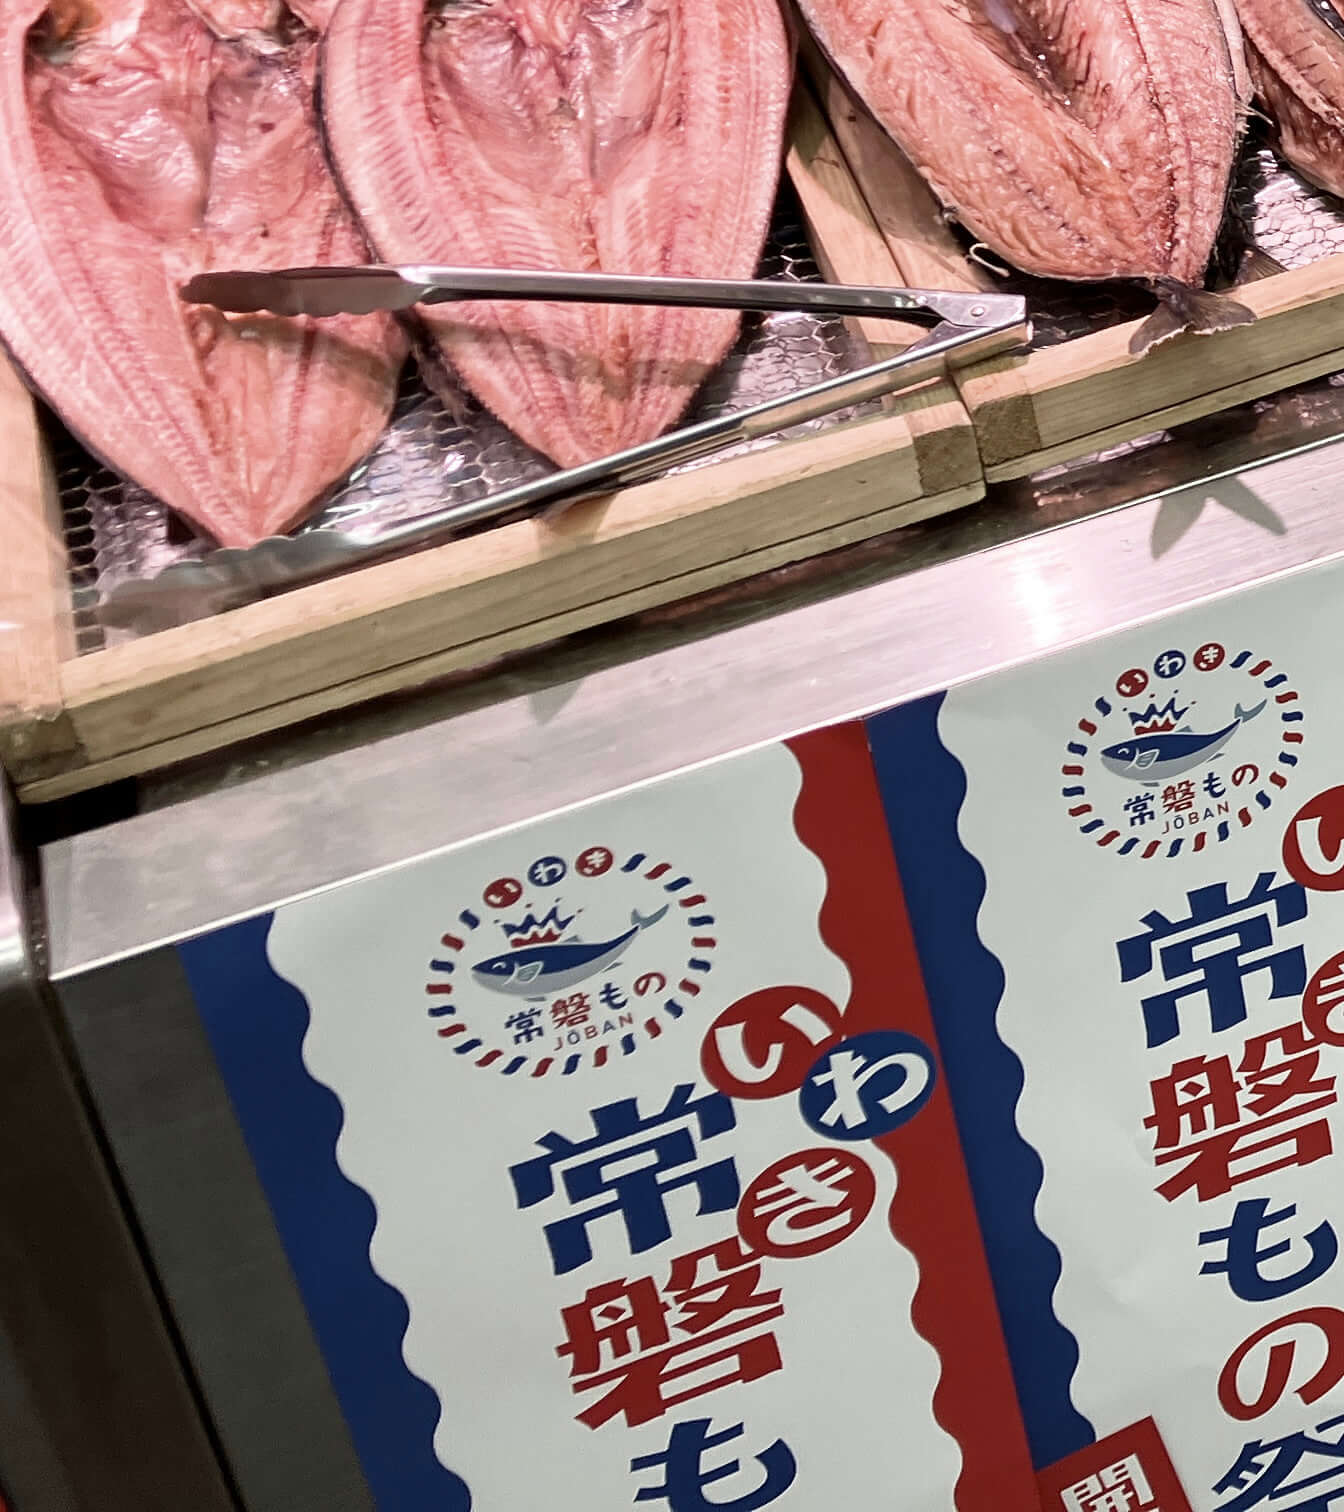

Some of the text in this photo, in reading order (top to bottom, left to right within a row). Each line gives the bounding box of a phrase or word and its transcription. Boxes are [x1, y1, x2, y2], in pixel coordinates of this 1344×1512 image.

[1123, 762, 1260, 826] 常磐もの
[505, 972, 668, 1046] 常磐もの
[508, 1083, 797, 1512] 常磐も
[1060, 1453, 1159, 1512] 開
